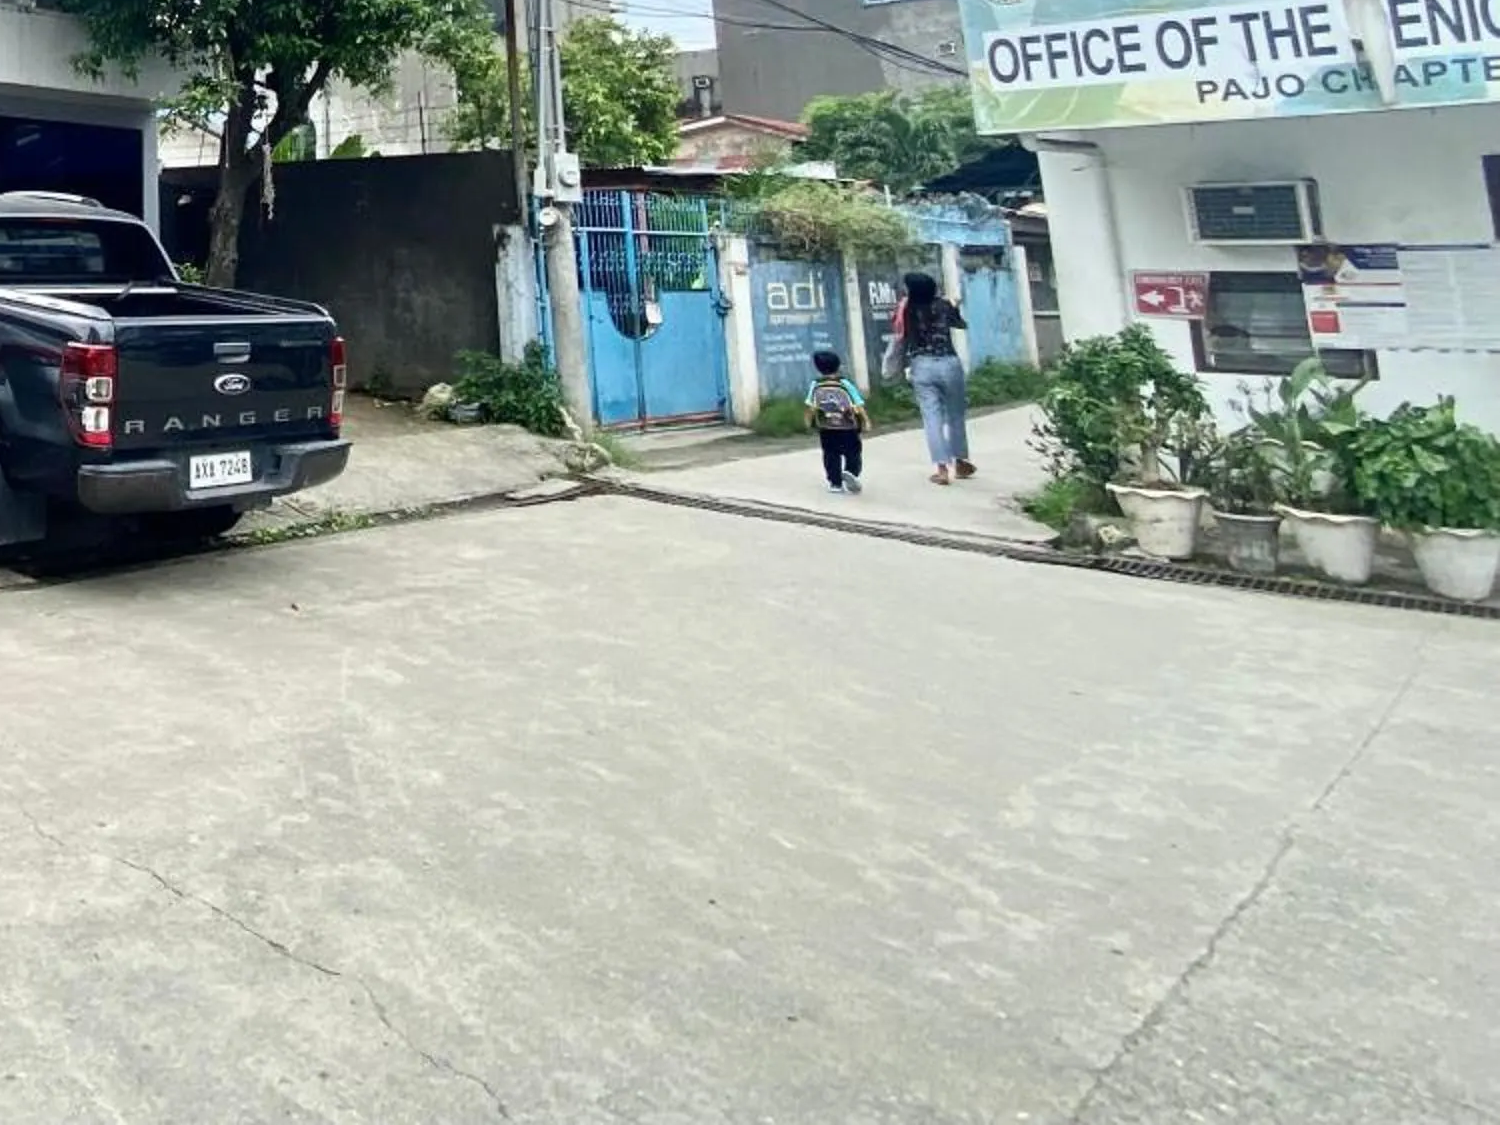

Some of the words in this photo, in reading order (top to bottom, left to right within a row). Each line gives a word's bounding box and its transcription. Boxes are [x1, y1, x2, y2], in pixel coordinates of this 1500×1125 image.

[987, 24, 1147, 85] OFFICE
[1155, 16, 1220, 73] OF
[1228, 3, 1338, 63] THE
[1198, 73, 1306, 105] PAJO
[766, 270, 825, 310] adi
[124, 405, 326, 435] RANGER
